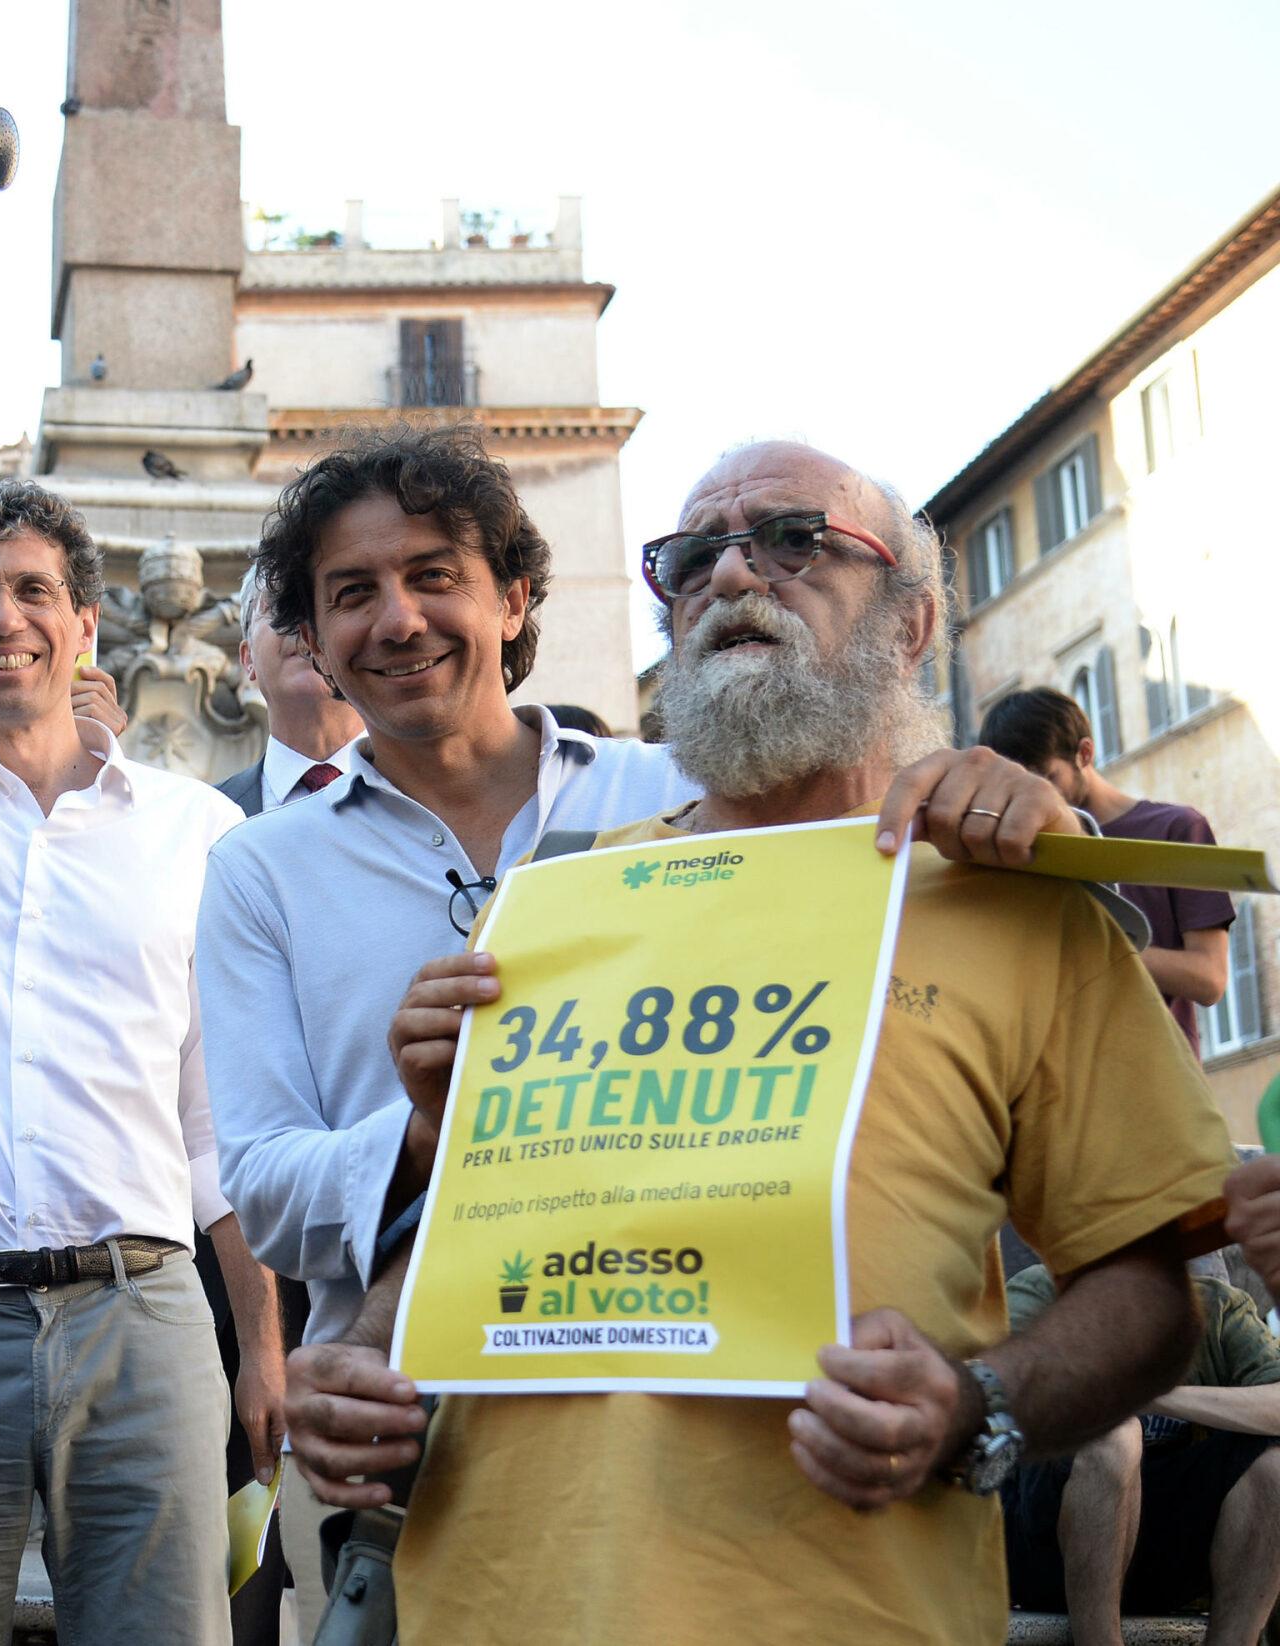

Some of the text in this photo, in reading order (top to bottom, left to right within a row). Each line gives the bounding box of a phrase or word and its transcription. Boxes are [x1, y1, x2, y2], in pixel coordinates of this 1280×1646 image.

[663, 867, 734, 887] legale
[666, 851, 743, 870] meglio
[491, 981, 830, 1073] 34,88%
[471, 1064, 817, 1143] DETENUTI
[463, 1125, 802, 1168] PER IL TESTO UNICO SULLE DROGHE
[454, 1181, 792, 1221] Il doppio rispetto alla media europea
[543, 1242, 703, 1277] adesso
[539, 1280, 709, 1315] al voto!
[494, 1327, 707, 1346] COLTIVAZIONE DOMESTICA
